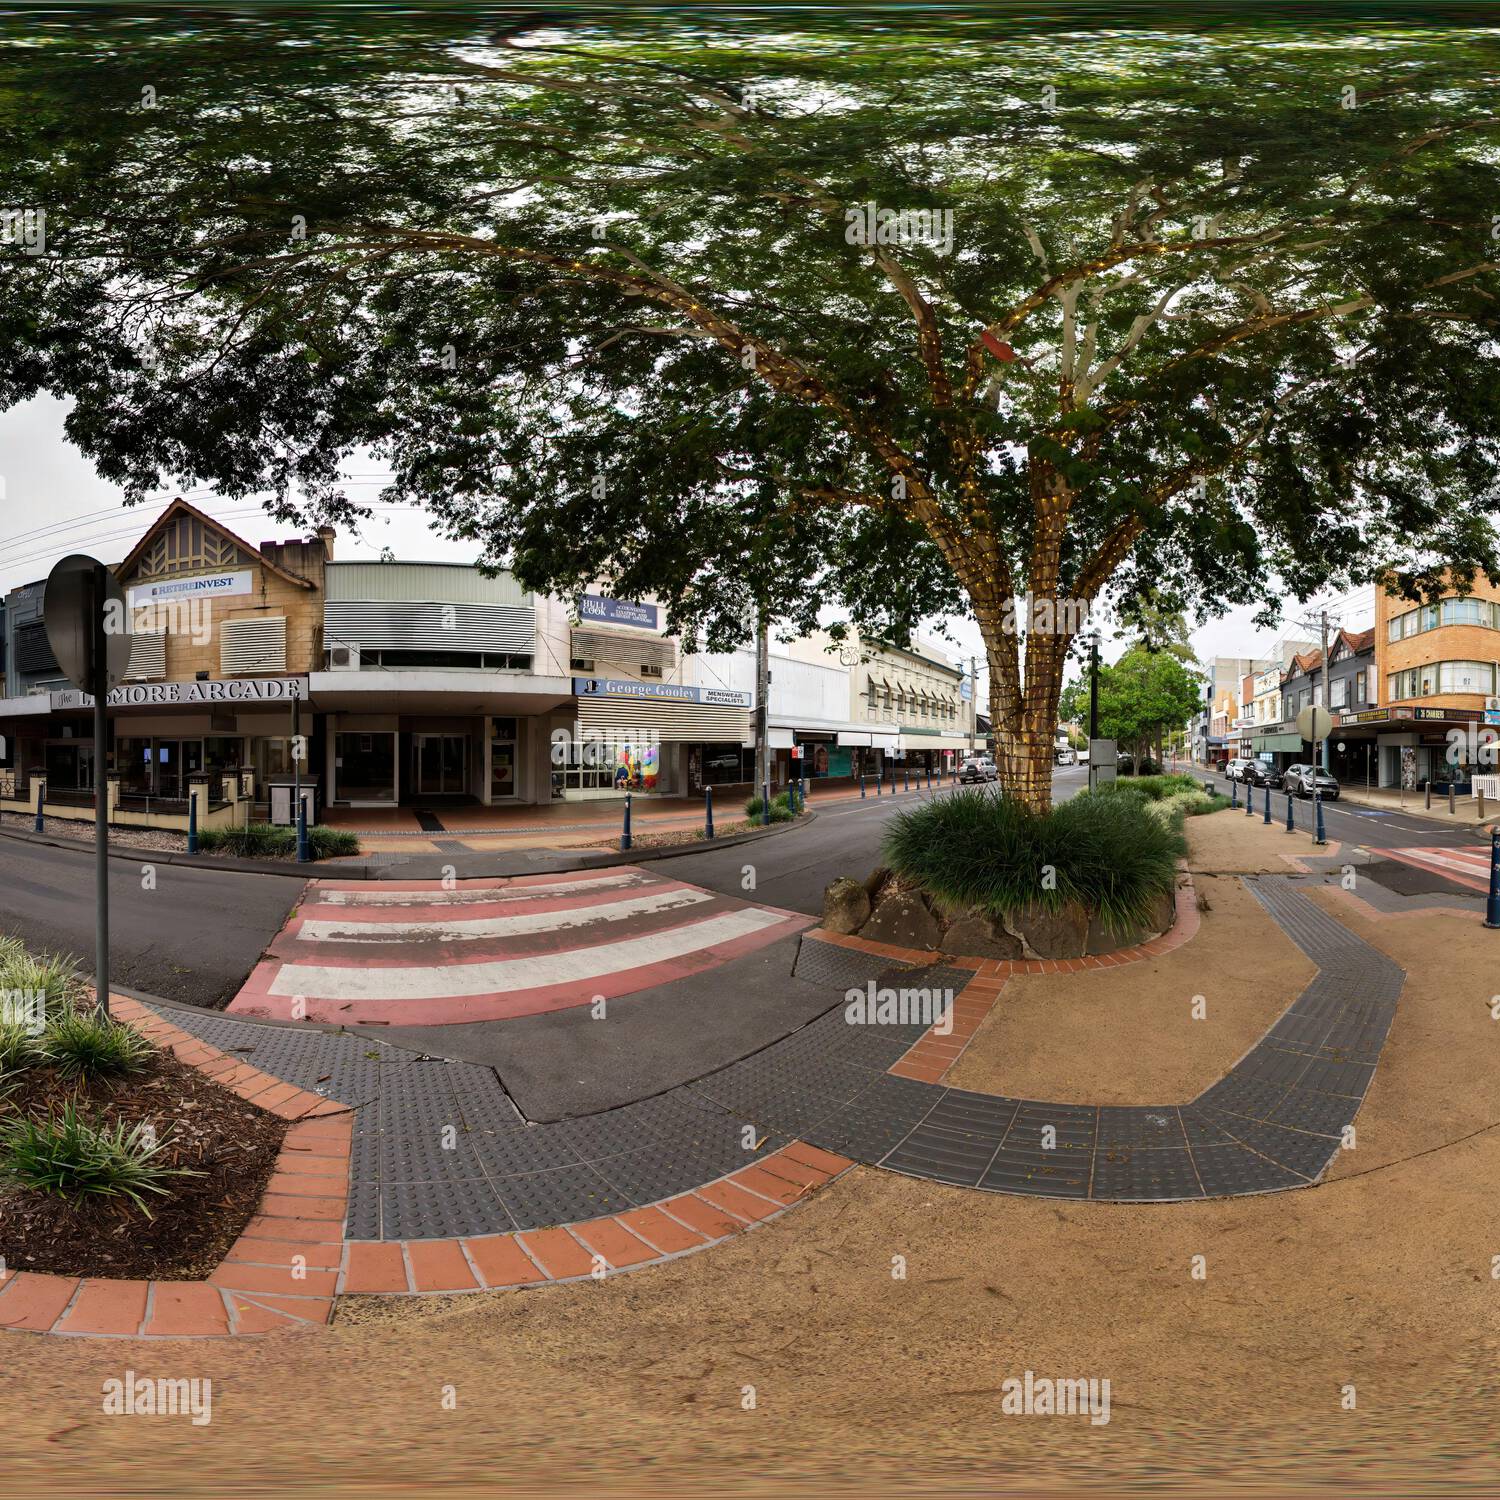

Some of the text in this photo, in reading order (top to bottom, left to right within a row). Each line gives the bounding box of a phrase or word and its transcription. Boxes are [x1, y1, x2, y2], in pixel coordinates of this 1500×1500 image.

[159, 577, 234, 595] RETIREINVEST
[583, 599, 605, 609] HULL
[583, 606, 607, 616] COOK
[58, 692, 73, 707] The
[185, 679, 301, 702] ARCADE
[606, 681, 695, 699] George Gooley
[707, 690, 744, 699] MENSWEAR
[705, 696, 745, 705] SPECIALISTS
